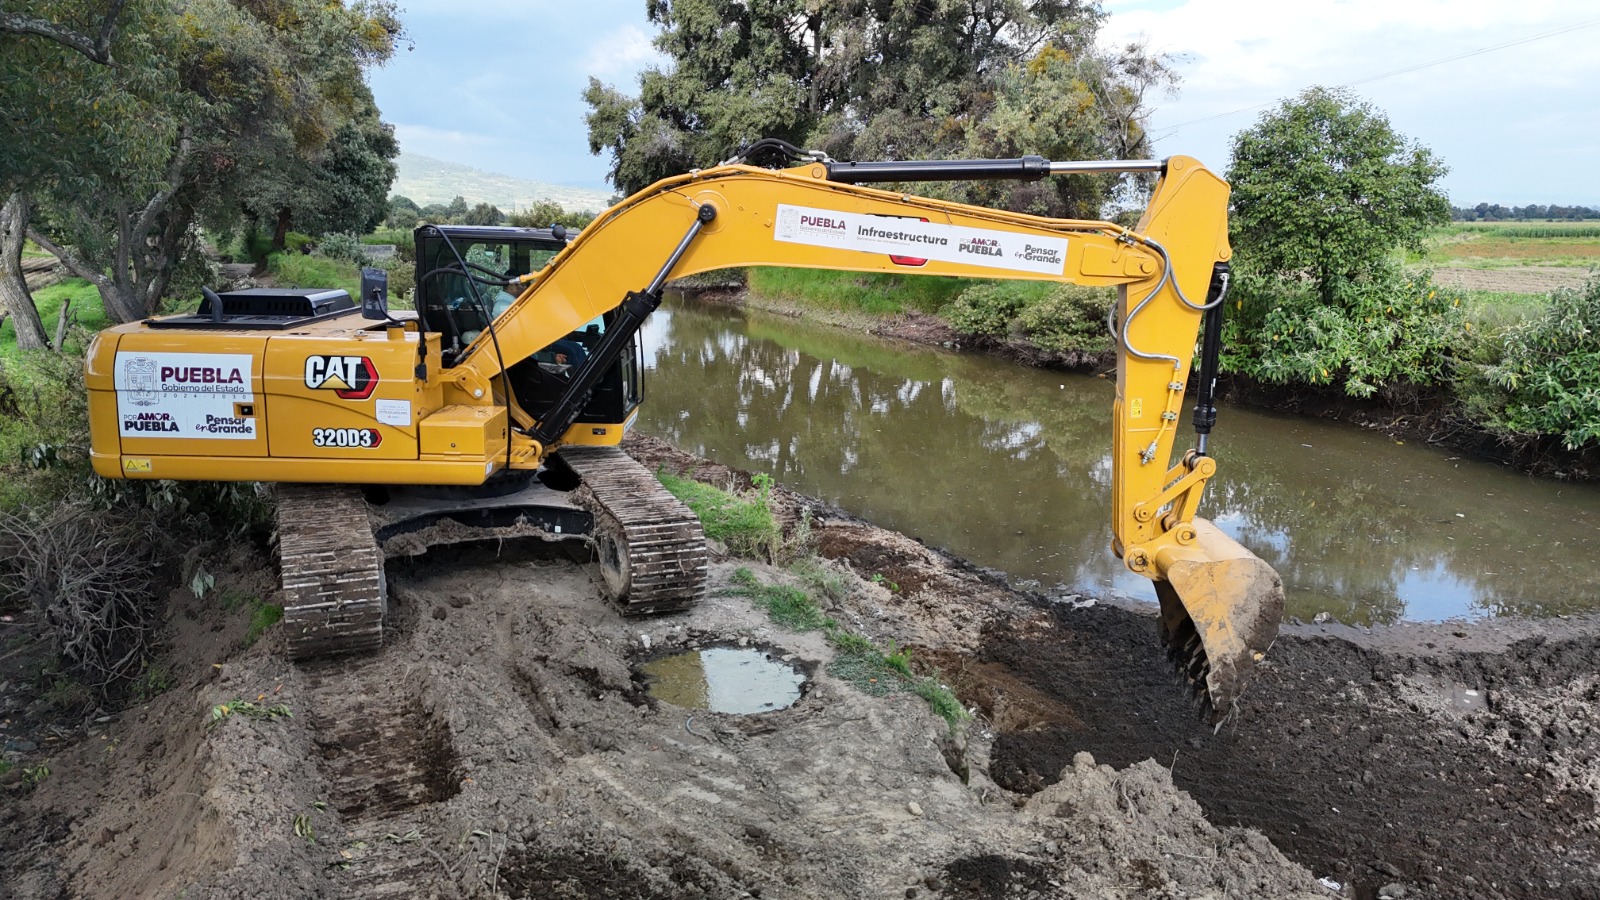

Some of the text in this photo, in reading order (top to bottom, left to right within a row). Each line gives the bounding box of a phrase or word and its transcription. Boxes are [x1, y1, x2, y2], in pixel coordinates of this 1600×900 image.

[800, 215, 846, 230] PUEBLA
[858, 225, 948, 246] Infraestructura
[971, 237, 998, 247] AMOR
[958, 243, 1003, 257] PUEBLA
[1024, 244, 1058, 256] Pensar
[1025, 252, 1061, 264] Grande
[161, 366, 244, 384] PUEBLA
[305, 355, 362, 389] CAT
[161, 383, 245, 393] Gobierno del Estado
[137, 412, 170, 421] AMOR
[124, 421, 180, 432] PUEBLA
[195, 423, 253, 434] en Grande
[313, 428, 372, 447] 320D3
